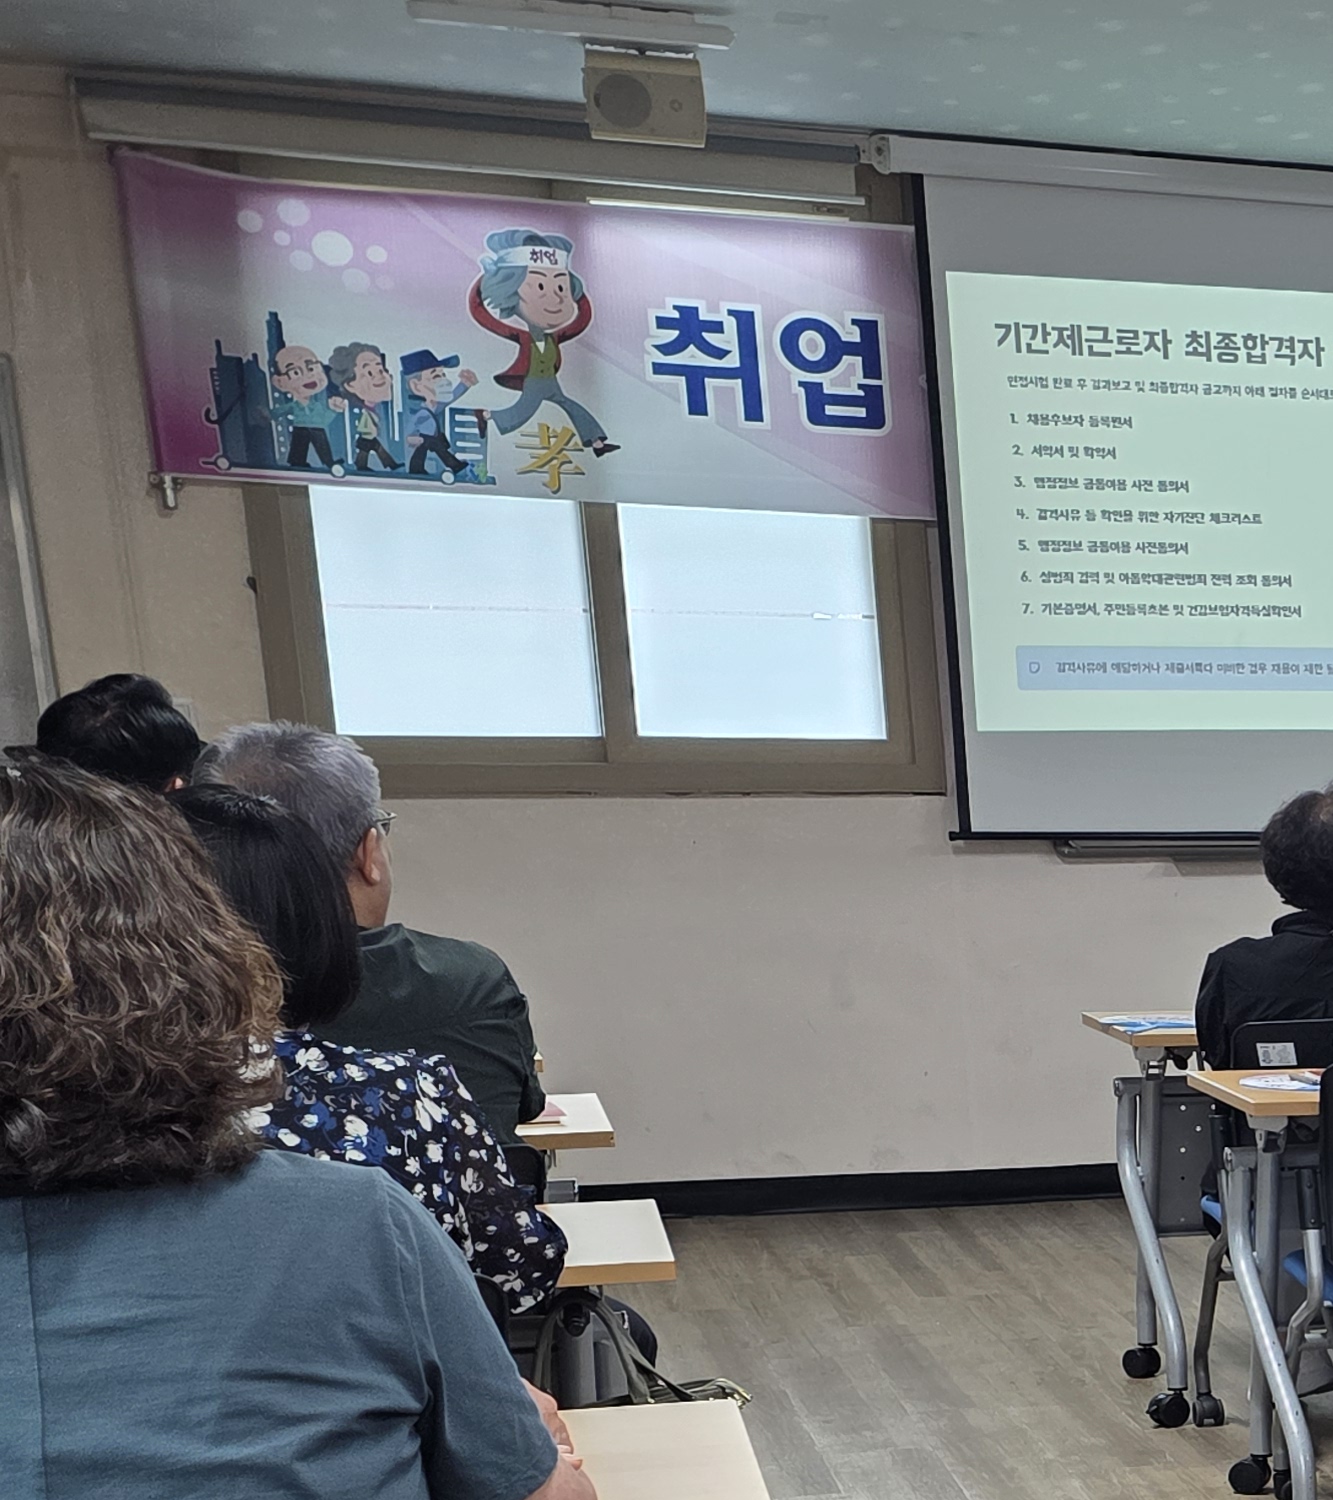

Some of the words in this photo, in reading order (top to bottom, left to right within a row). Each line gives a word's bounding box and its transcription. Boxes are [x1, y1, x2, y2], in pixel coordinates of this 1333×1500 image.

[530, 248, 558, 265] 취업
[994, 321, 1173, 360] 기간제근로자
[1184, 330, 1325, 367] 최종합격자
[648, 301, 888, 433] 취업
[1135, 380, 1145, 393] 및
[1244, 385, 1265, 398] 아래
[1031, 444, 1065, 458] 서약서
[1067, 446, 1079, 458] 및
[1014, 476, 1026, 488] 3.
[1131, 480, 1153, 492] 사전
[1157, 480, 1190, 493] 동의서
[1015, 508, 1029, 520] 4.
[1137, 511, 1160, 523] 위한
[1209, 512, 1263, 525] 체크리스트
[1018, 539, 1030, 551] 5.
[1020, 571, 1032, 583] 6.
[1103, 572, 1115, 584] 및
[1235, 574, 1257, 587] 조회
[1260, 575, 1292, 588] 동의서
[1022, 602, 1034, 615] 7.
[1173, 604, 1184, 617] 및
